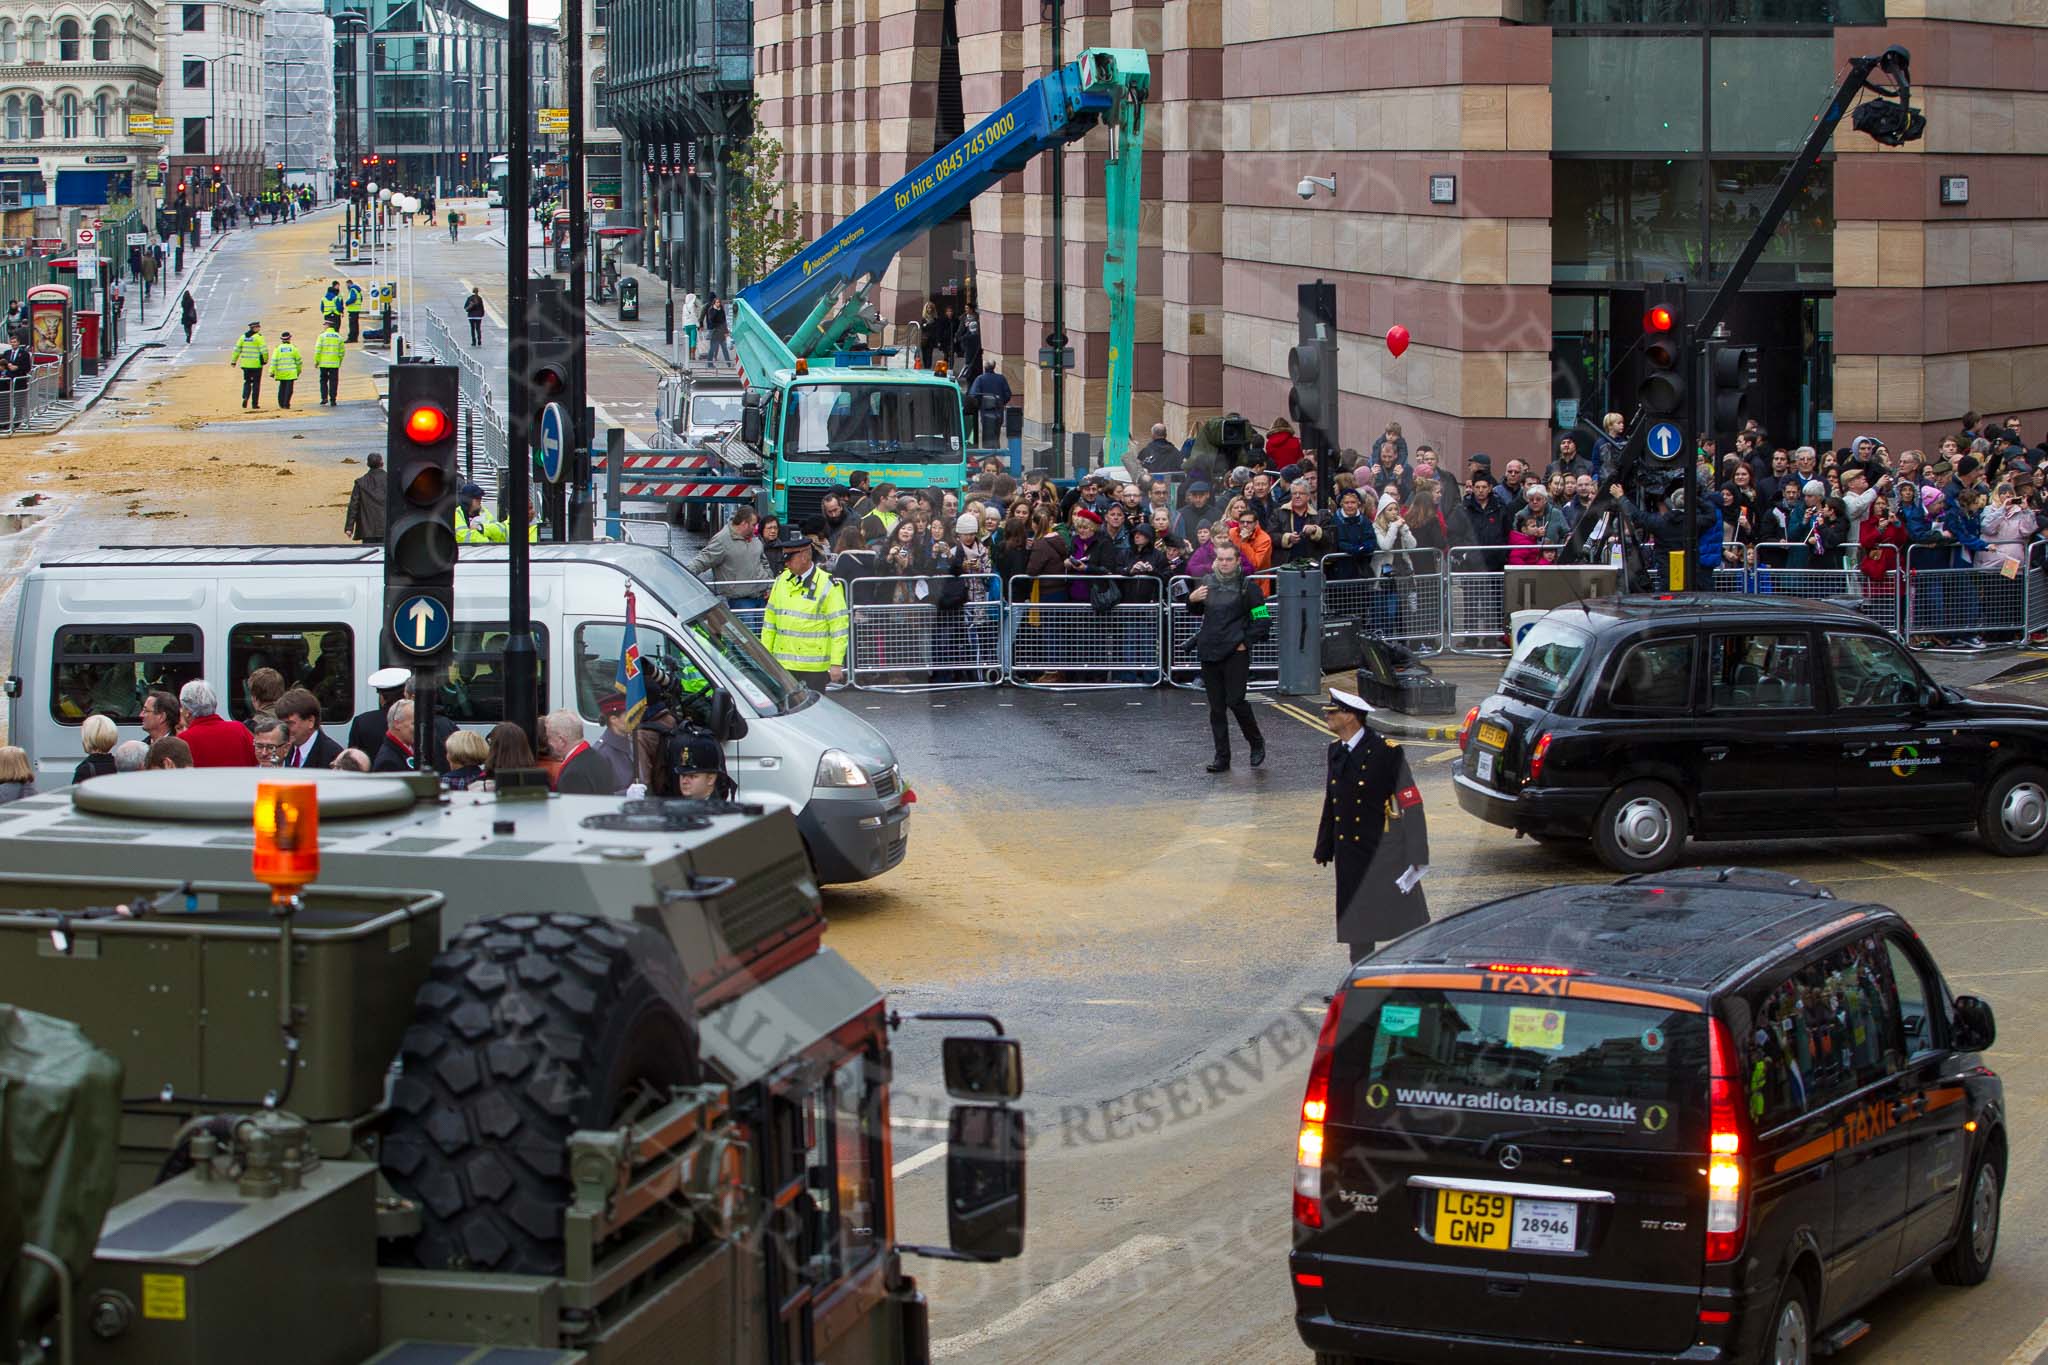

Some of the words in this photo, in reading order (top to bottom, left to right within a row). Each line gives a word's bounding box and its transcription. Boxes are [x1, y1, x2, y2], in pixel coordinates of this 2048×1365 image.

[648, 143, 656, 164] HSBC
[660, 144, 668, 165] HSBC
[673, 142, 681, 164] HSBC
[688, 141, 696, 164] HSBC
[894, 190, 911, 211] for
[911, 172, 936, 200] hire:
[935, 148, 964, 182] 0845
[963, 138, 985, 161] 745
[985, 112, 1015, 146] 0000
[811, 244, 840, 269] Nationwide
[840, 226, 865, 248] Platforms
[792, 476, 836, 485] VOLVO
[1868, 756, 1942, 768] www.radiotaxis.co.uk
[1485, 974, 1569, 997] TAXI
[1396, 1087, 1637, 1121] www.radiotaxis.co.uk
[1443, 1193, 1506, 1219] LG59
[1449, 1219, 1496, 1244] GNP
[1521, 1217, 1569, 1234] 28946
